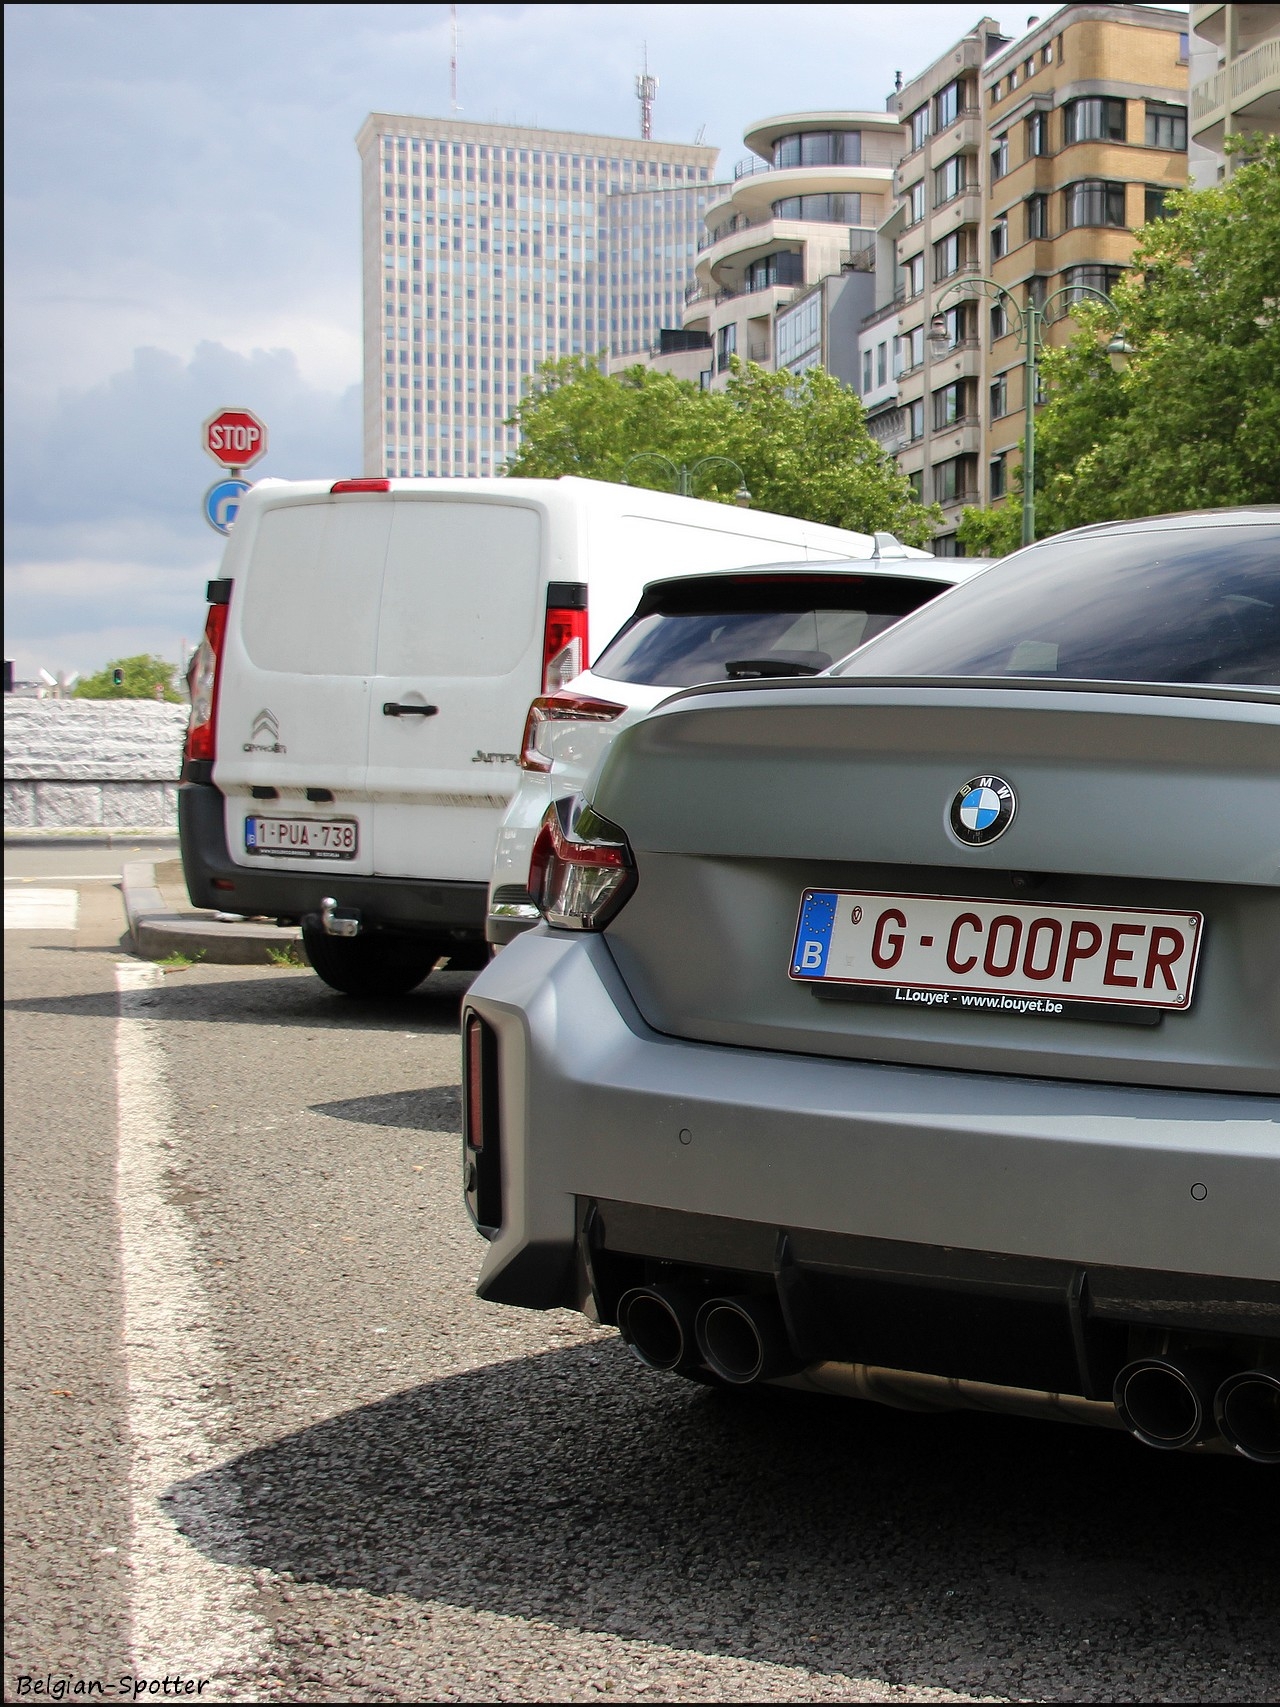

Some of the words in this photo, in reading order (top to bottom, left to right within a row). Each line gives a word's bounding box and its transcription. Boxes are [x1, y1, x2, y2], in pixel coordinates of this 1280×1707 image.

[210, 425, 260, 451] STOP
[960, 777, 1011, 800] BMW
[250, 834, 256, 844] B
[259, 823, 353, 848] 1-PUA-738
[801, 940, 824, 969] B
[895, 988, 949, 1005] L.Louyet
[961, 994, 1063, 1014] www.louyet.be
